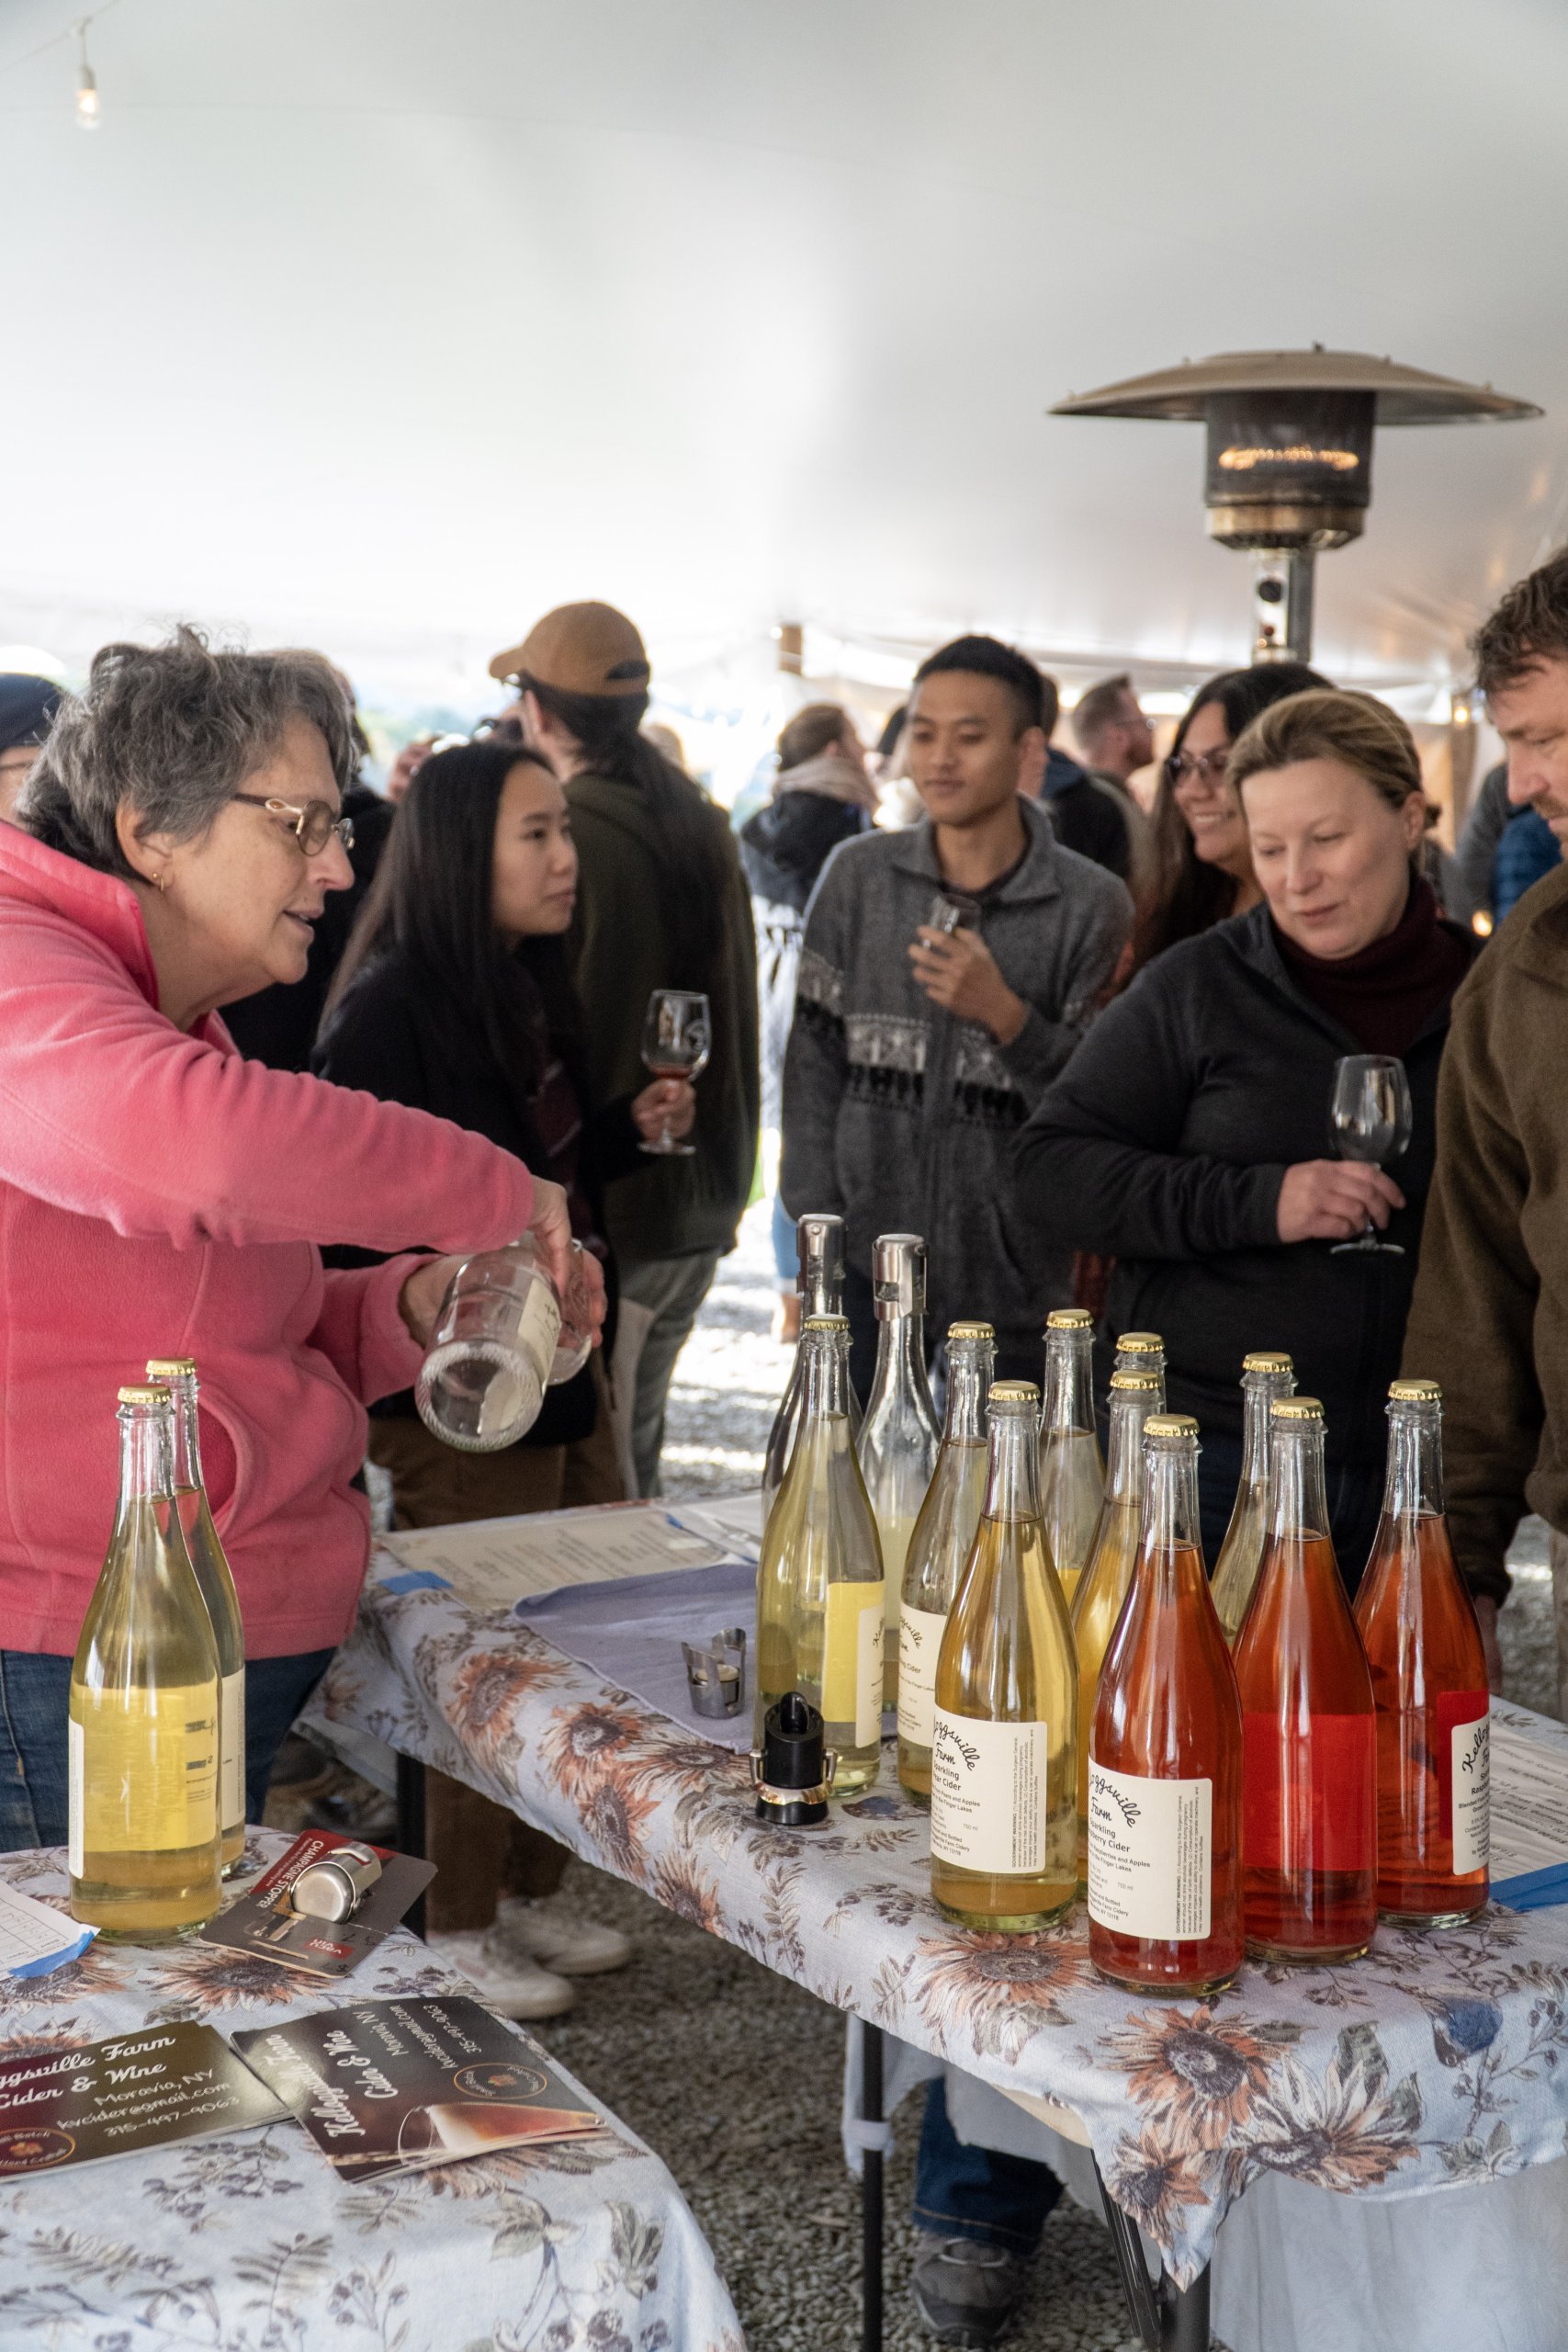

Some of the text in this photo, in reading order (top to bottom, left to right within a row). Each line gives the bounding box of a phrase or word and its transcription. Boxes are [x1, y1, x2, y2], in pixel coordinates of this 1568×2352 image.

[942, 1778, 962, 1791] Cider
[957, 1804, 973, 1814] Lakes
[962, 1798, 981, 1807] Apples
[1090, 1796, 1112, 1822] Farm
[1108, 1840, 1131, 1853] Cider
[256, 1840, 324, 1908] CHAMPAGNE STOPPER
[1115, 1863, 1132, 1872] Lakes
[1129, 1859, 1151, 1868] Apples
[352, 2010, 410, 2058] Moravia, NY
[423, 2004, 483, 2054] 315-497-9063
[101, 2035, 176, 2062] Farm
[322, 2030, 360, 2057] Wine
[71, 2075, 97, 2093] &
[105, 2063, 167, 2086] Wine
[94, 2067, 213, 2107] Moravia, NY
[355, 2068, 399, 2099] Cider
[56, 2082, 230, 2131] kvcider@gmail.com
[277, 2062, 366, 2138] Kelloggsville
[103, 2096, 241, 2138] 315-497-9063
